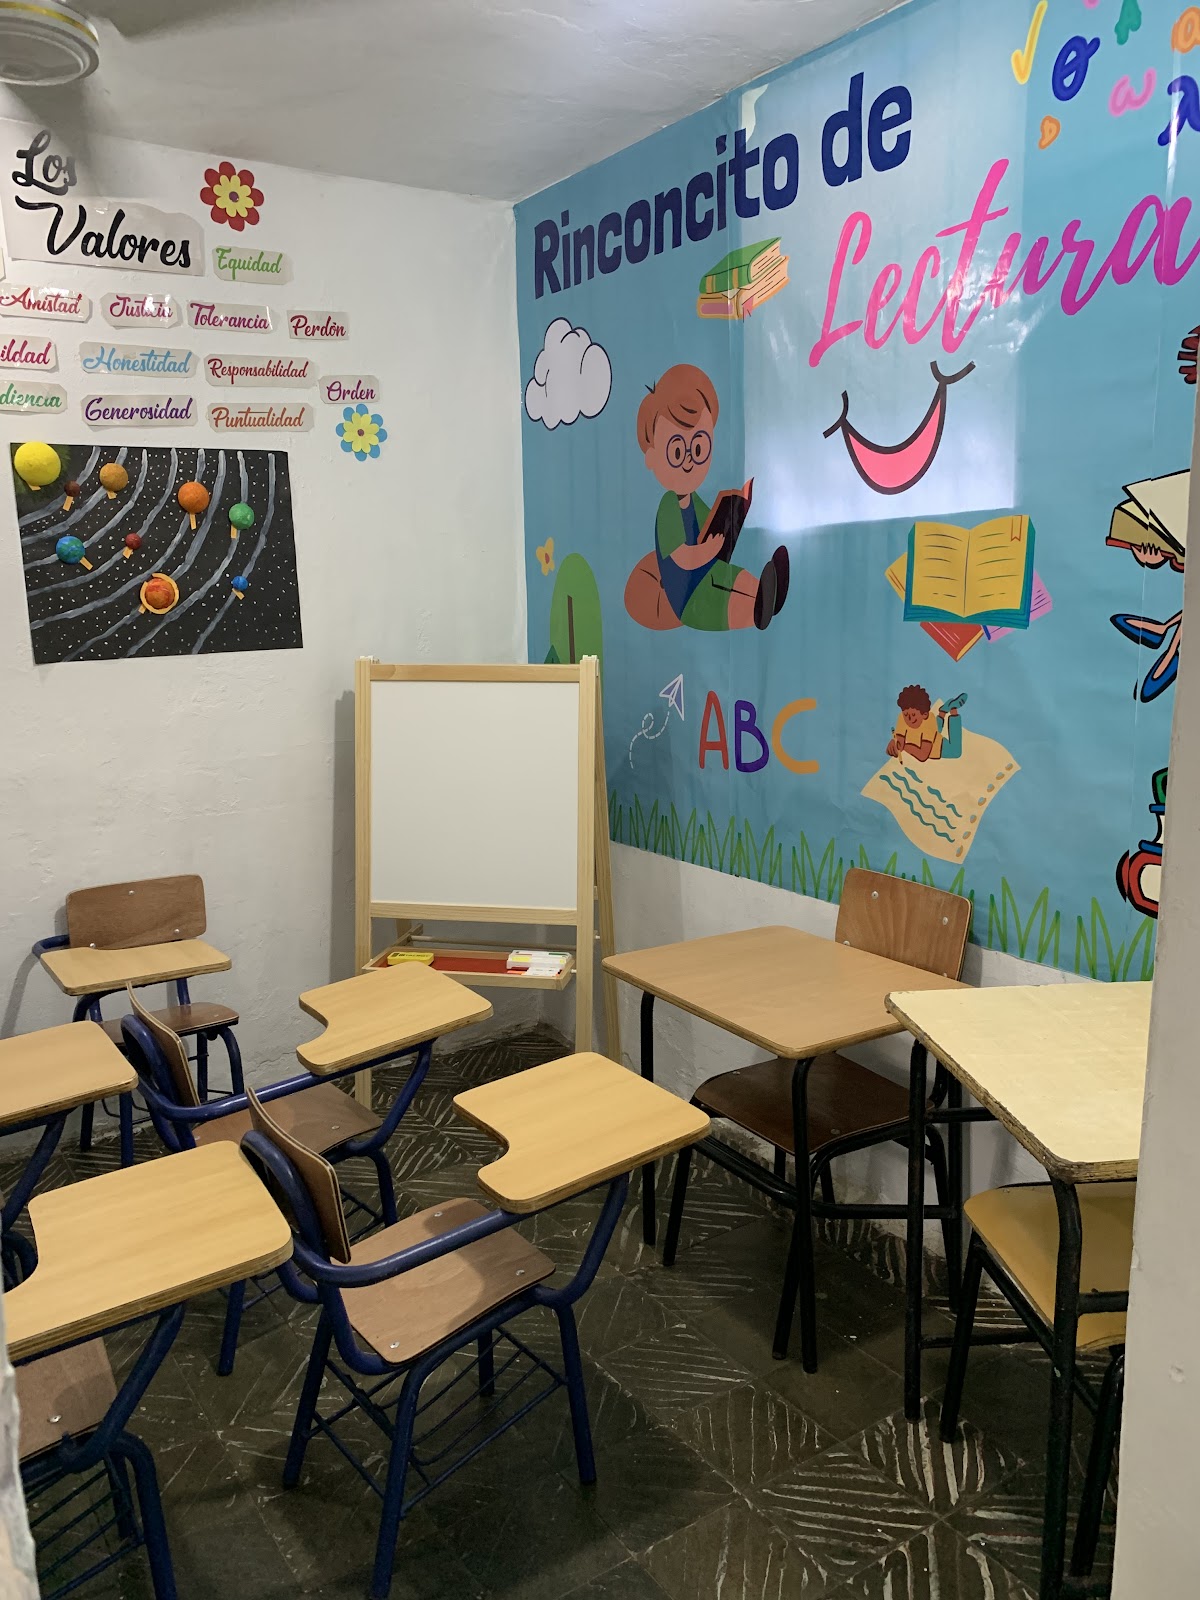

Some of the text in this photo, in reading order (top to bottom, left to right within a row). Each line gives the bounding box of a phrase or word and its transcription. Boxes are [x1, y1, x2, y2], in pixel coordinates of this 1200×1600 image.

[12, 129, 77, 196] Los
[534, 72, 912, 299] Rinconcito de
[15, 195, 191, 268] Valores
[215, 247, 283, 280] Equidad
[809, 158, 1200, 367] Lectura
[0, 287, 82, 314] Amistad
[190, 302, 270, 330] Tolerancia
[83, 345, 192, 374] Honestidad
[207, 357, 309, 385] Responsabilidad
[326, 379, 376, 402] Orden
[85, 397, 192, 421] Generosidad
[211, 406, 306, 428] Puntualidad
[699, 690, 819, 774] ABC
